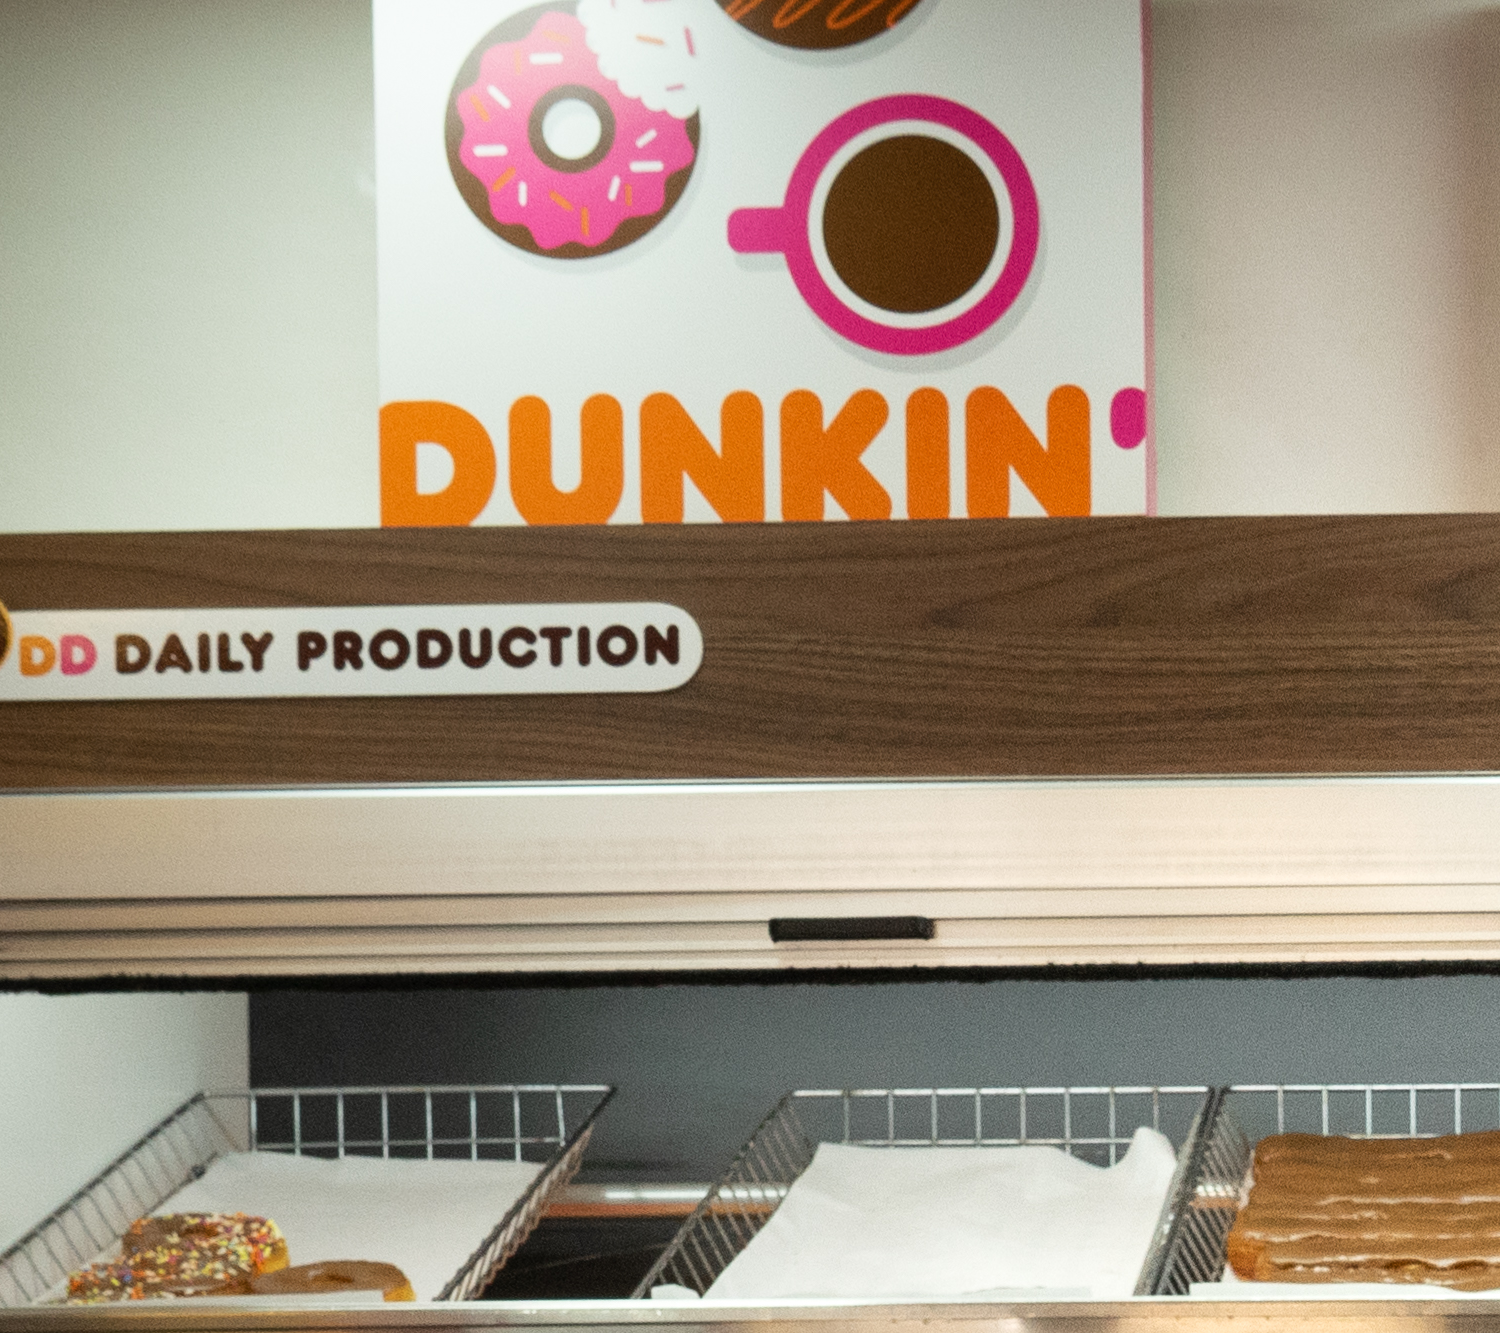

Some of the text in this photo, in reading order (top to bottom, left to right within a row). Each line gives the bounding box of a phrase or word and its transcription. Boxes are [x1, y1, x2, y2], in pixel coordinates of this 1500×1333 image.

[379, 384, 1148, 528] DUNKIN'
[114, 632, 275, 674] DAILY
[298, 624, 682, 671] PRODUCTION
